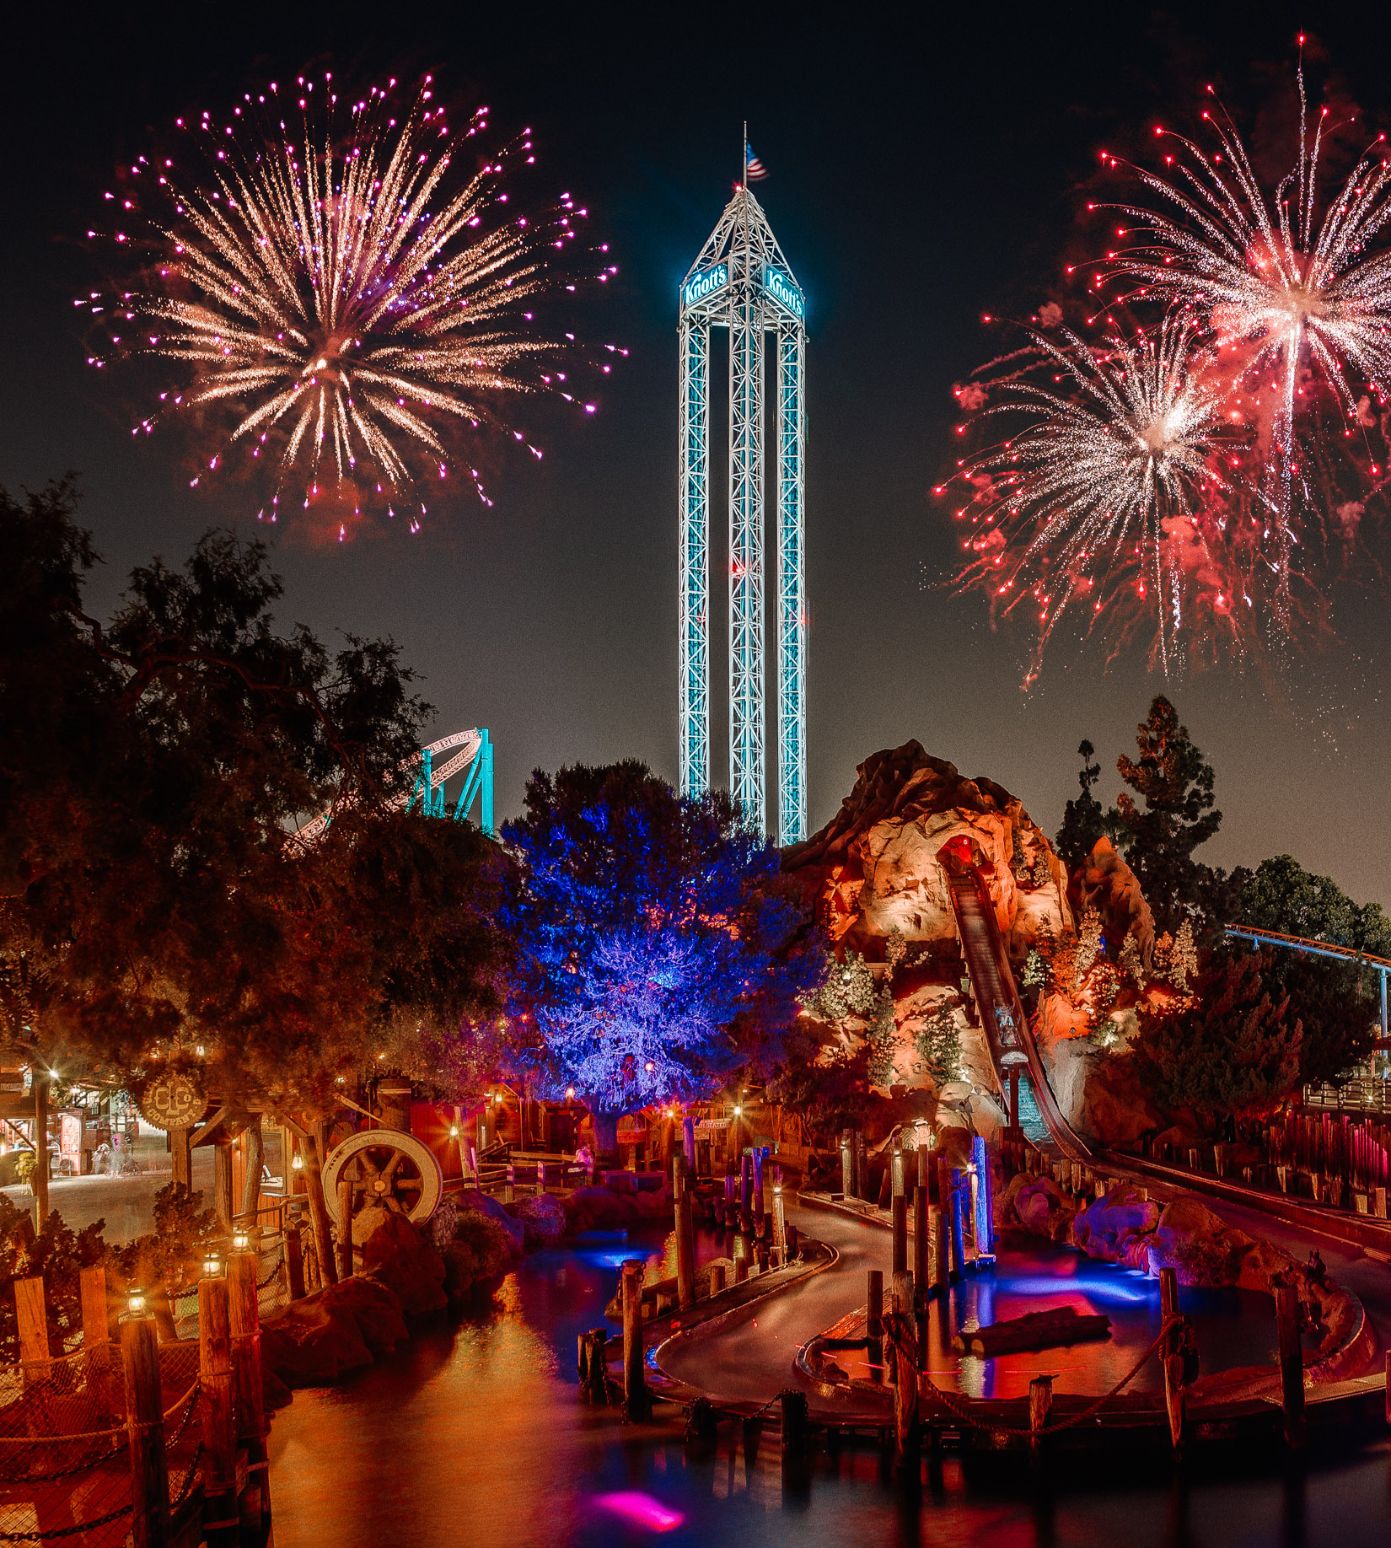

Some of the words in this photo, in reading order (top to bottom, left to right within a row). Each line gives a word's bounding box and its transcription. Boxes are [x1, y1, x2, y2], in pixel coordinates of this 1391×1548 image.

[685, 265, 728, 305] Knott's
[767, 270, 803, 315] Knott's
[146, 1108, 196, 1126] COMPANY
